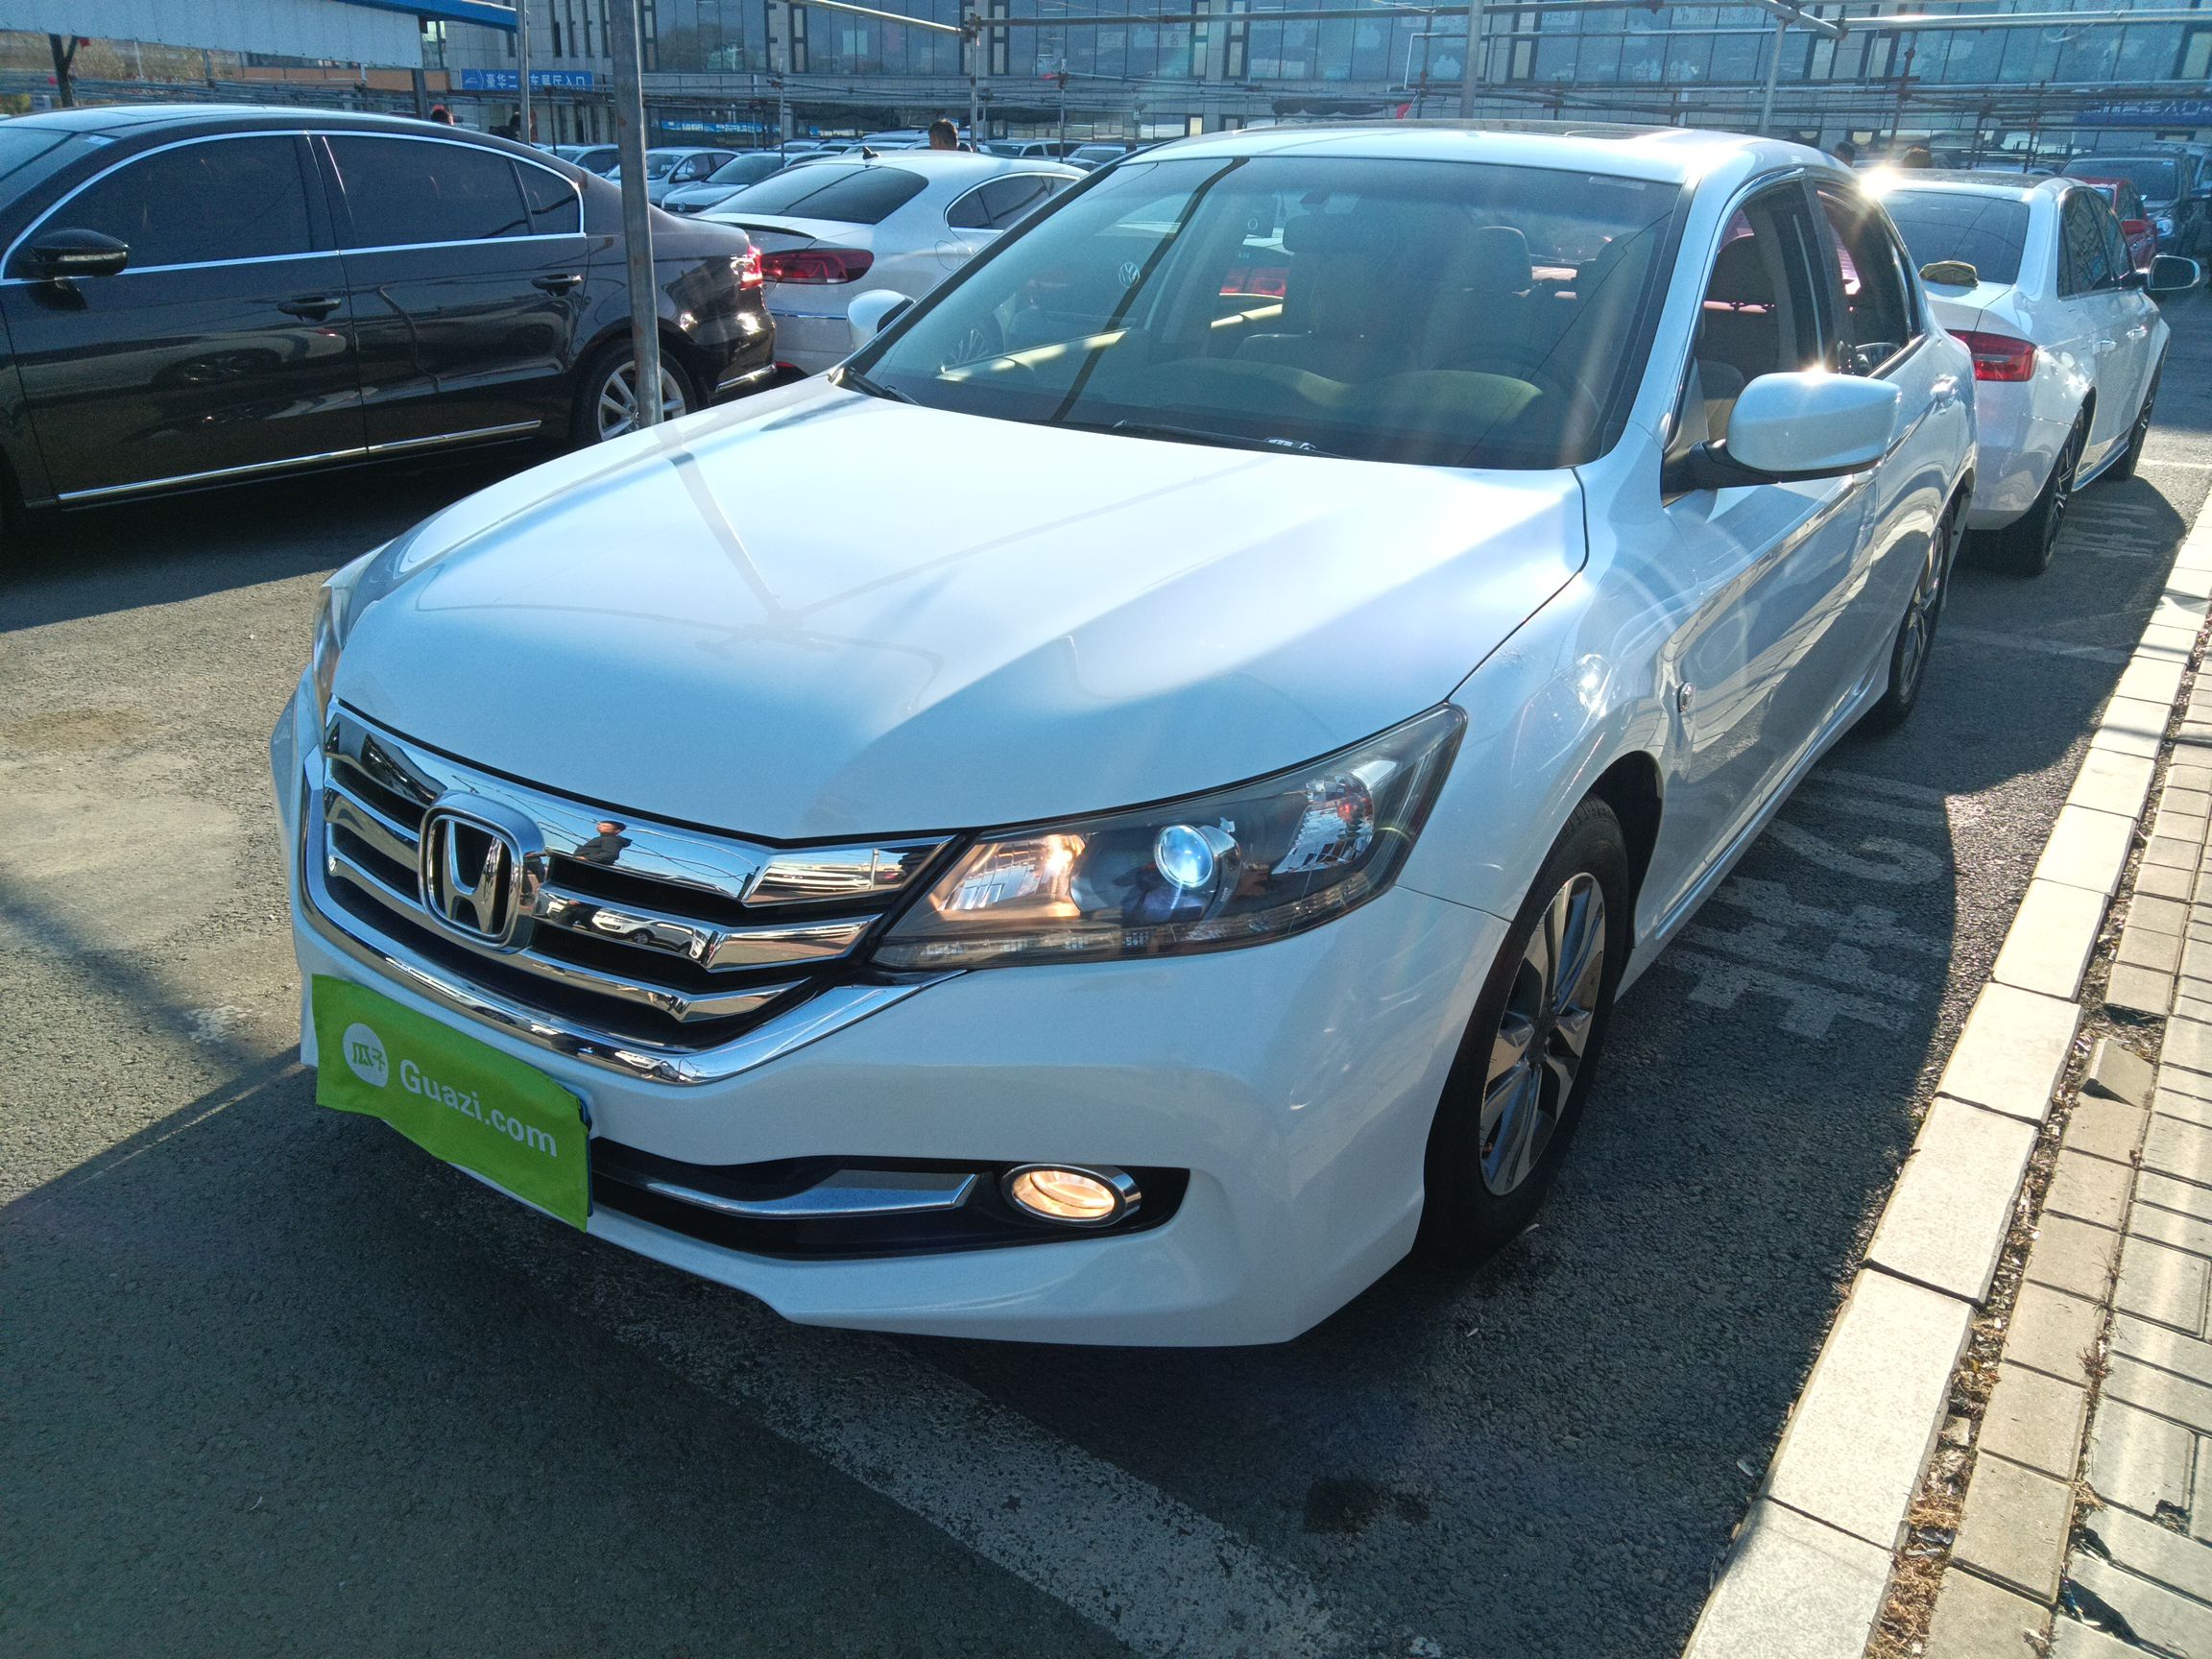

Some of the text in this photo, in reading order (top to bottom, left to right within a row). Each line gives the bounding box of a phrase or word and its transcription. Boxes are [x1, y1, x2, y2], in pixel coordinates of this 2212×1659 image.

[486, 73, 585, 89] 豪华二车展厅入口
[351, 1041, 386, 1073] 瓜子
[399, 1058, 558, 1158] Guazi.com
